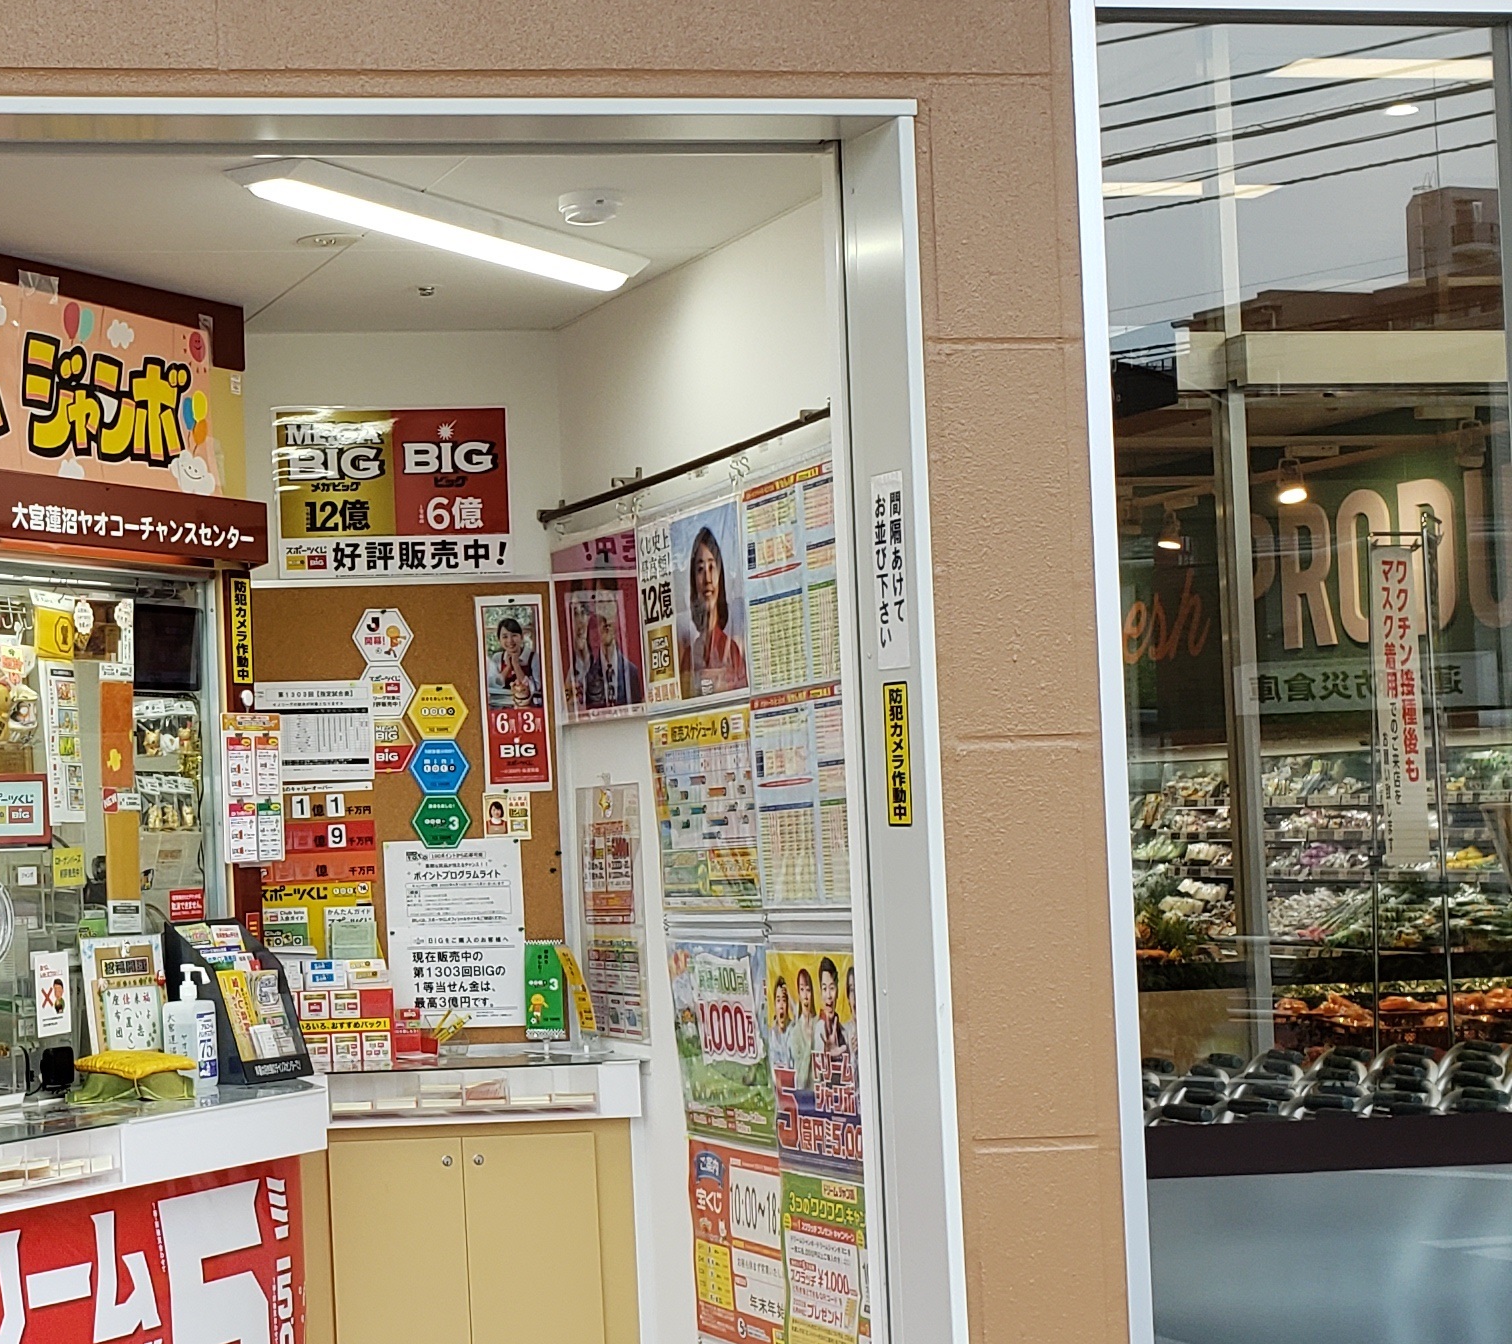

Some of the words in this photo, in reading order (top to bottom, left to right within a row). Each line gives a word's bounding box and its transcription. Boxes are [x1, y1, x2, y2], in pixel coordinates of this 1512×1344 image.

[21, 330, 191, 470] ジャンボ
[288, 447, 385, 481] BIG
[402, 441, 496, 475] BIG
[11, 501, 255, 549] 大宮蓮沼ヤオコーチャンスセンター
[305, 500, 371, 533] 12億
[426, 496, 484, 531] 6億
[285, 545, 328, 555] スポーツくじ
[332, 539, 507, 572] 好評販売中!
[889, 490, 905, 623] 間隔あけて
[874, 493, 892, 649] お並び下さい
[641, 581, 674, 626] 12億
[233, 580, 250, 681] 防犯カメラ作動中
[652, 650, 670, 670] BIG
[1394, 560, 1420, 783] ワクチン接種後も
[376, 752, 400, 762] BIG
[499, 744, 536, 758] BIG
[888, 688, 907, 821] 防犯カメラ作動中
[11, 809, 31, 820] BIG
[414, 869, 501, 881] ポイントプログラムライト
[412, 951, 483, 963] 現在販売中の
[413, 965, 506, 978] 第1303回BIGの
[414, 981, 497, 993] 1等当せん金は、
[414, 996, 495, 1009] 最高3億円です。
[199, 1039, 214, 1058] 75
[695, 1187, 723, 1214] 宝くじ
